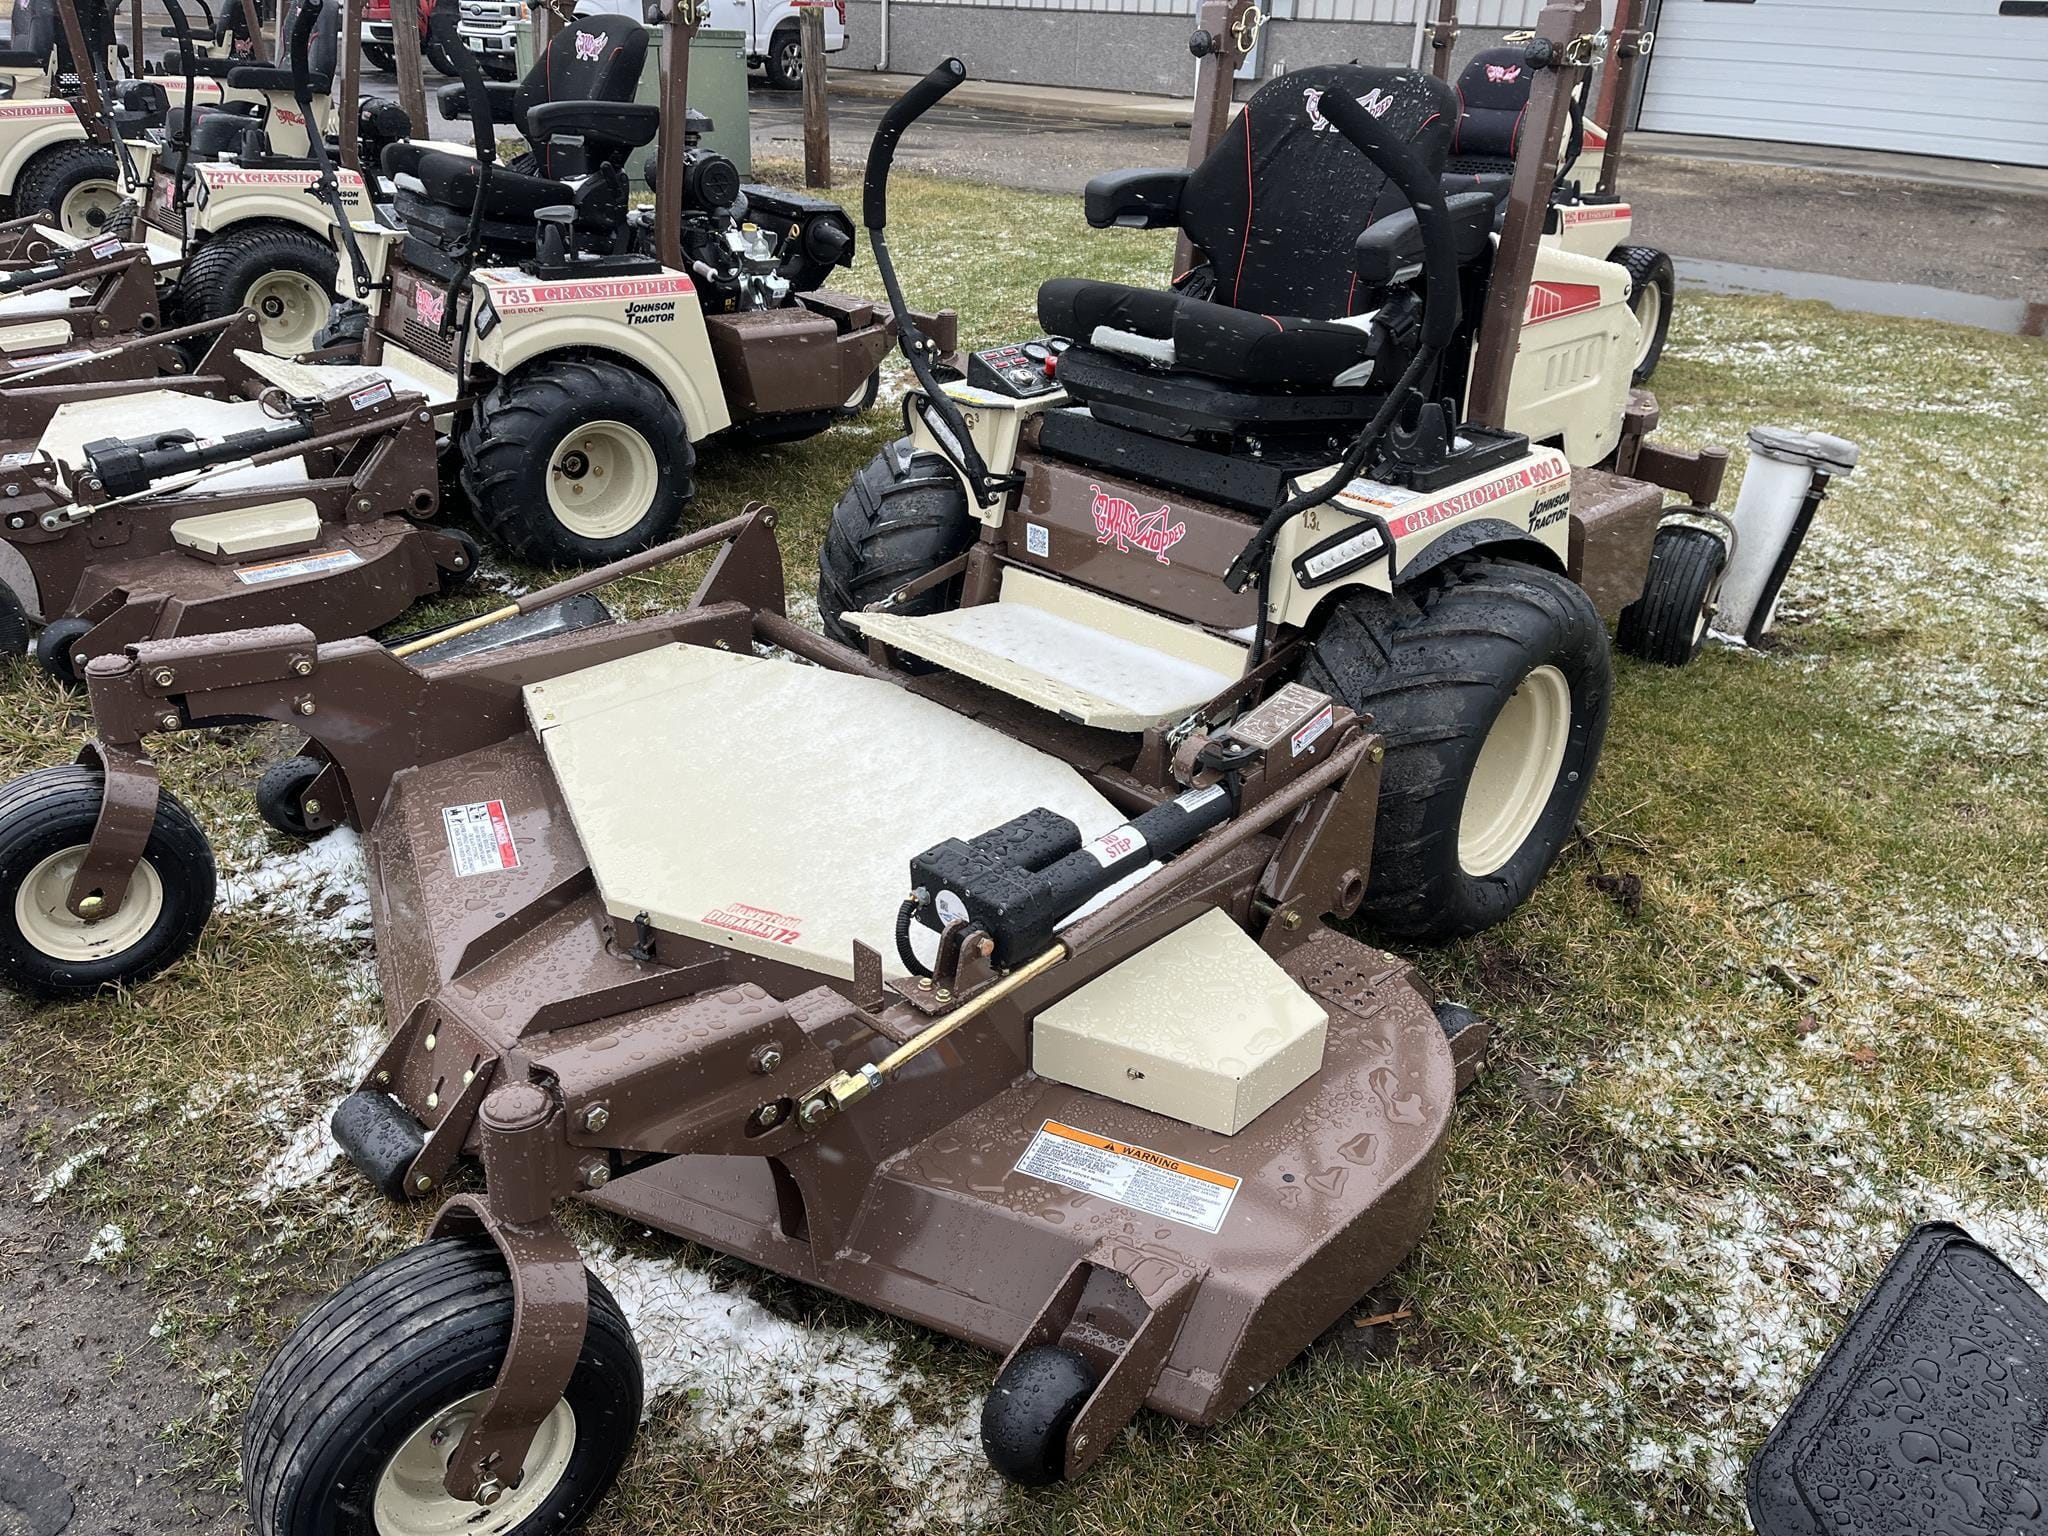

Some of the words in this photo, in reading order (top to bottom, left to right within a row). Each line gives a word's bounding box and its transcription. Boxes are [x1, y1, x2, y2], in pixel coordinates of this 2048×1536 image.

[0, 106, 65, 117] SSHOPPER
[207, 172, 246, 184] 727K
[250, 173, 355, 185] GRASSHOER
[497, 289, 530, 304] 735
[544, 280, 679, 300] GRASSHOPPER
[624, 302, 675, 313] JOHNSON
[626, 312, 675, 325] TRACTOR
[1405, 472, 1525, 533] GRASSHOPPER
[1529, 461, 1552, 483] 900
[1551, 457, 1563, 475] D
[1529, 491, 1570, 518] JOHNSON
[1528, 508, 1569, 533] TRACTOR
[1100, 834, 1119, 845] NO
[1105, 838, 1131, 858] STEP
[1122, 1146, 1180, 1171] WARNING
